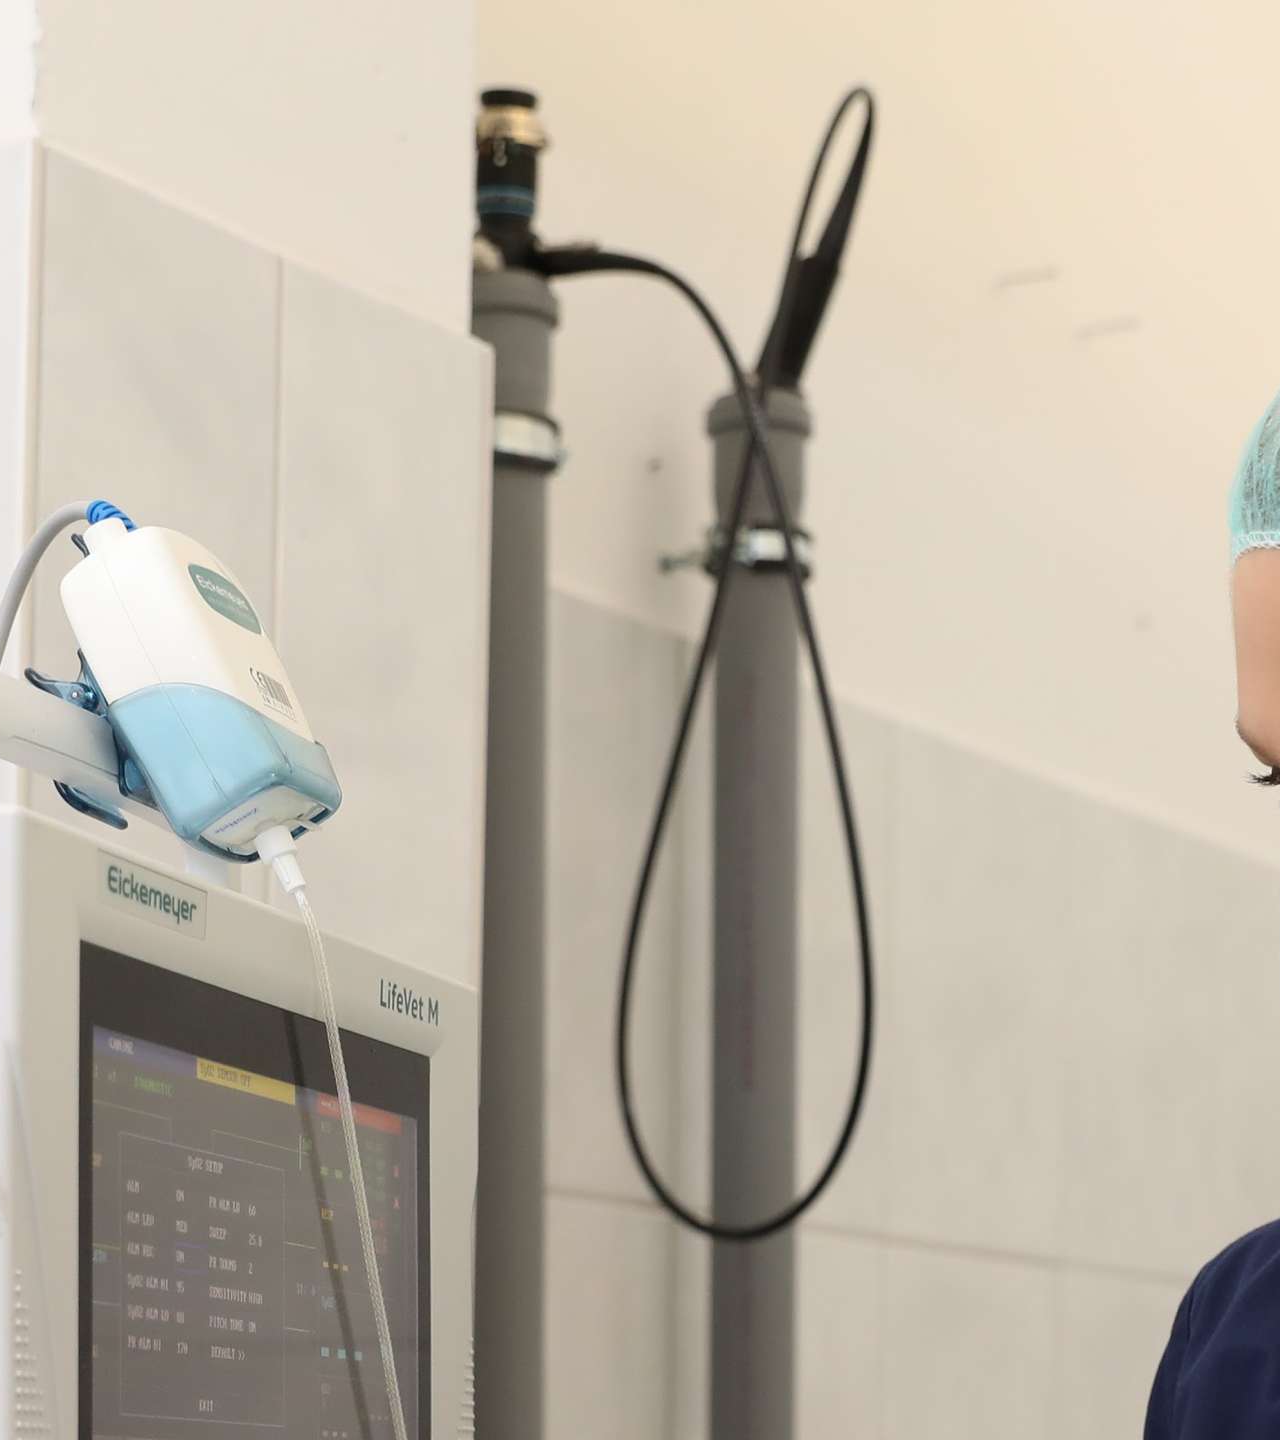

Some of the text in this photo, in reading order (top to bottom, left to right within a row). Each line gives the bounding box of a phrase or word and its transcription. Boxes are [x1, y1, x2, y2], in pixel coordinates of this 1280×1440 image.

[108, 865, 197, 925] Eickemeyer
[380, 978, 439, 1027] LifeVet M
